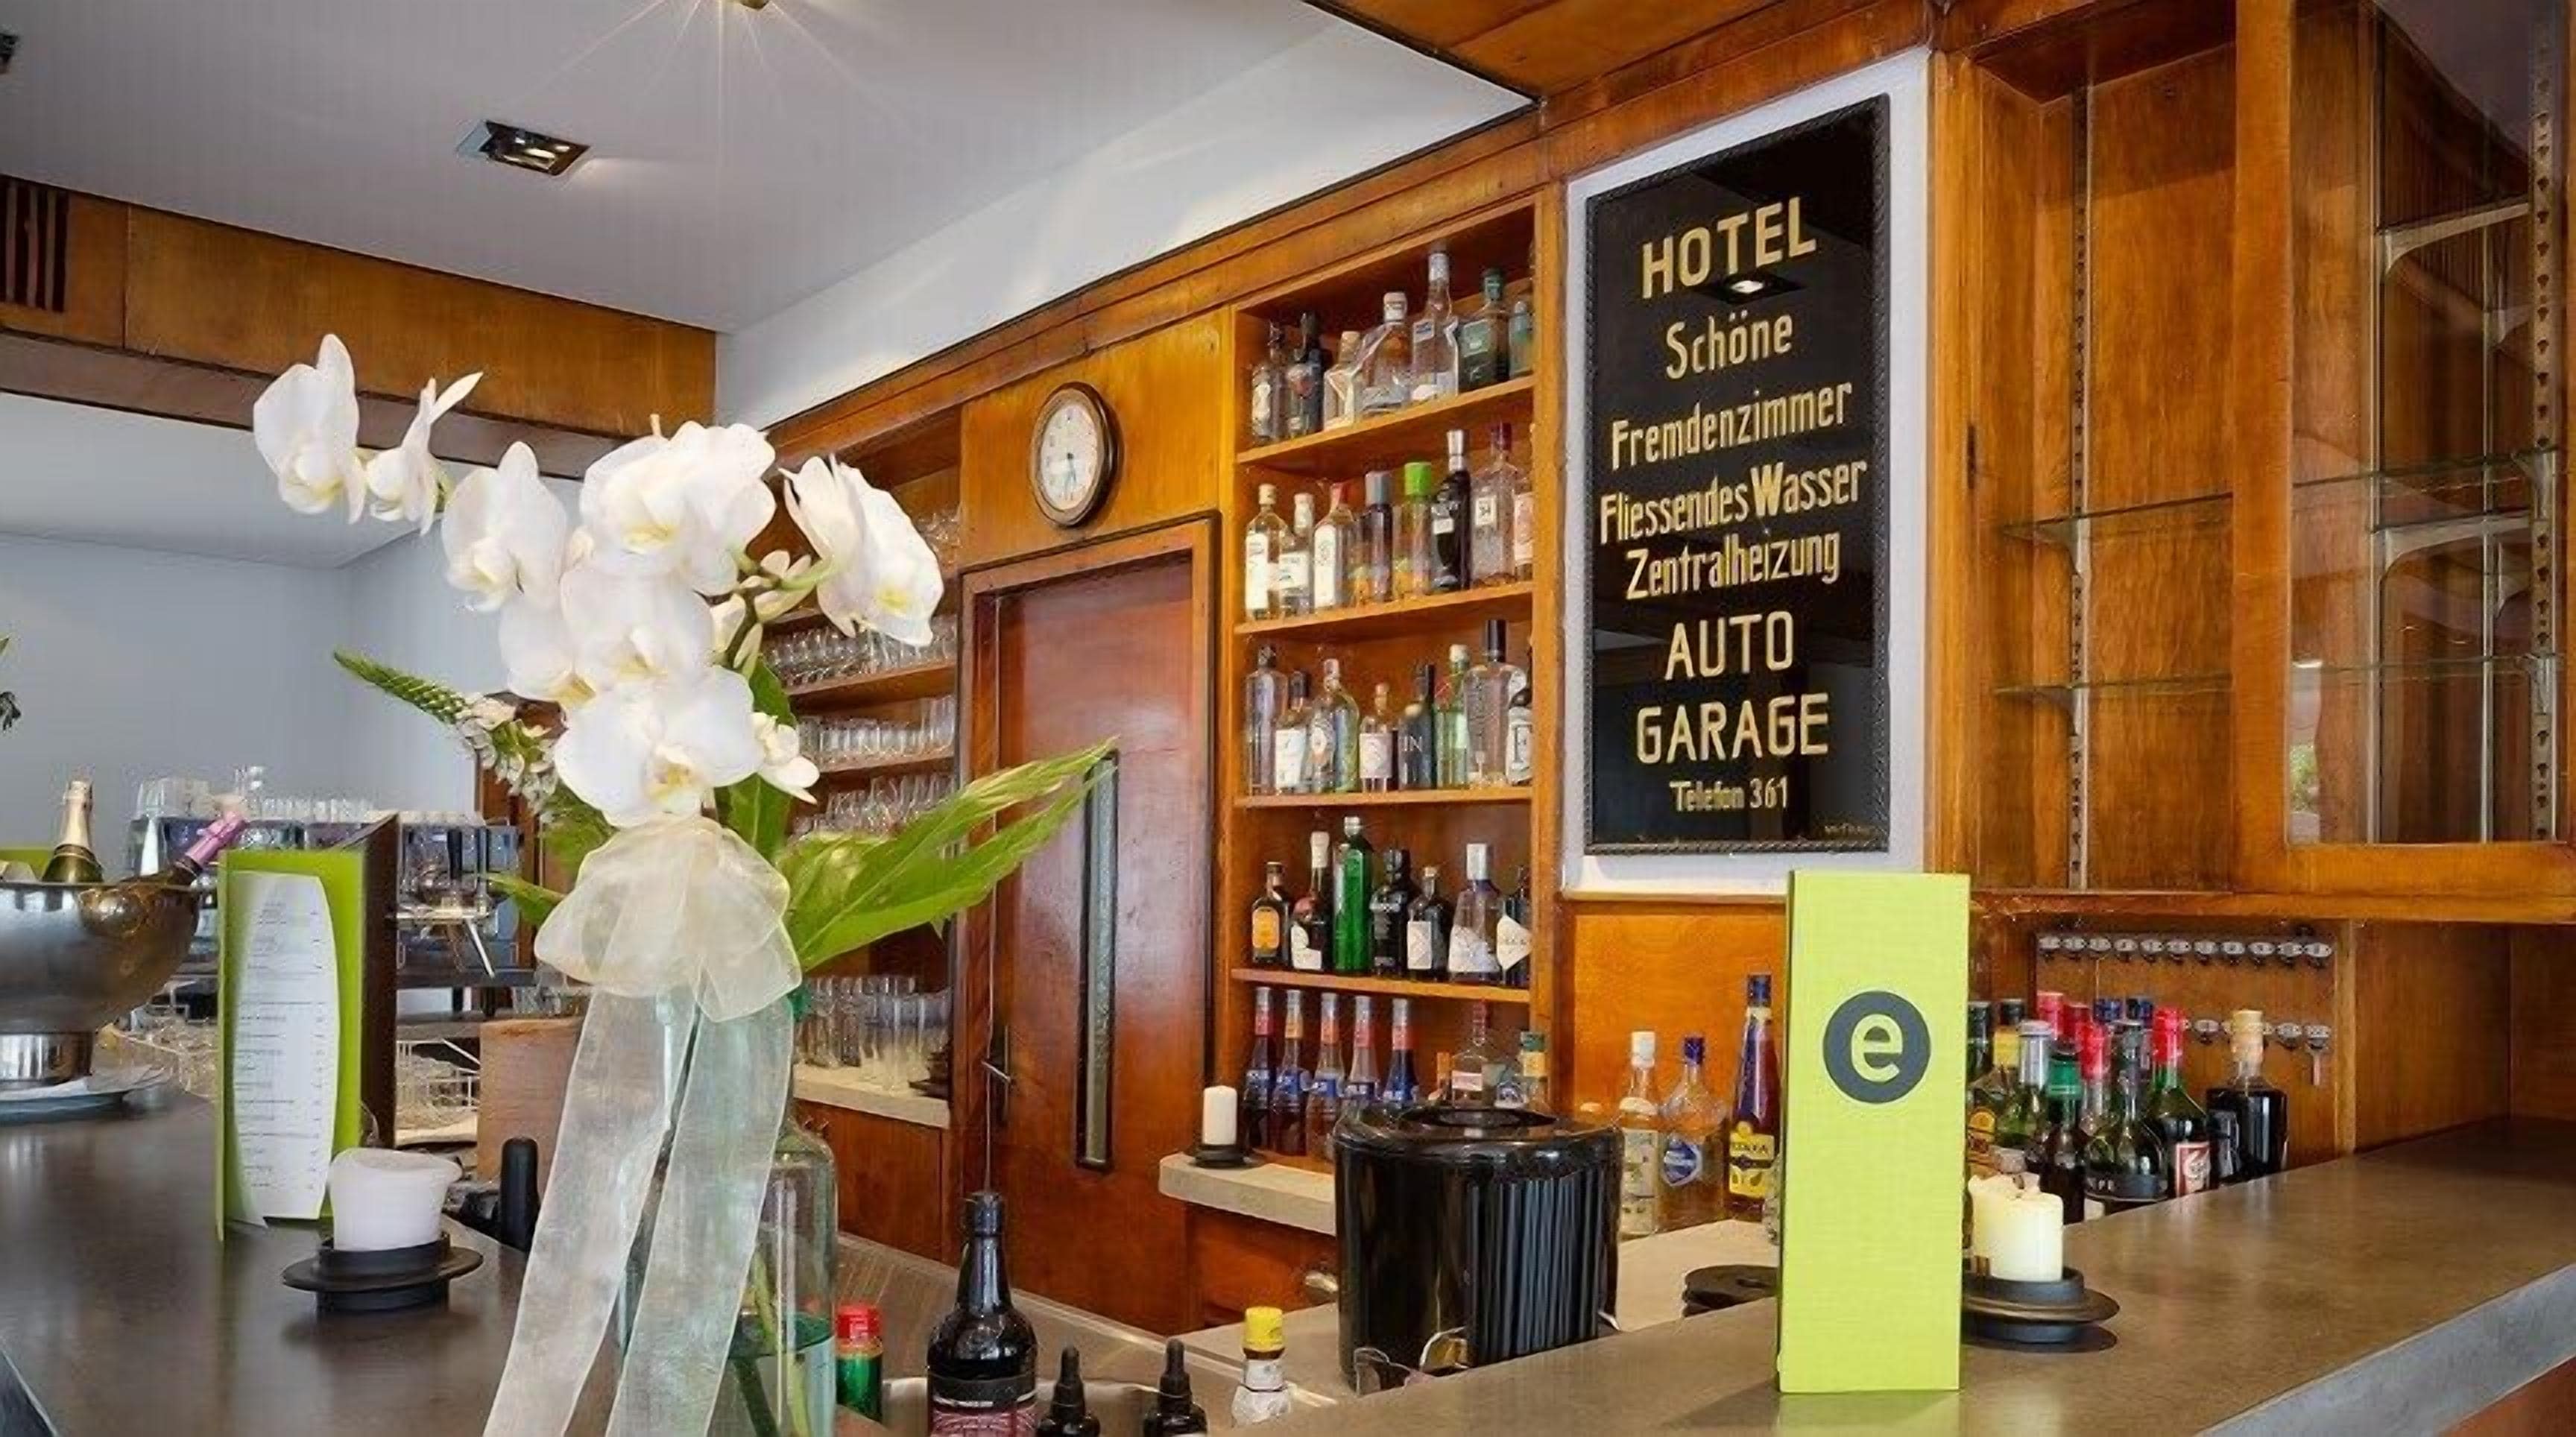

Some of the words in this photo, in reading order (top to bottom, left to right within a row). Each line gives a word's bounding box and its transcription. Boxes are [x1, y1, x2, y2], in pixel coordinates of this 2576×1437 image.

[1641, 197, 1816, 299] HOTEL
[1666, 309, 1793, 379] Schöne
[1611, 382, 1852, 471] Fremdenzimmer
[1750, 460, 1868, 517] Wasser
[1626, 527, 1840, 600] Zentralheizung
[1664, 610, 1794, 680] AUTO
[1638, 693, 1829, 764] GARAGE
[1669, 780, 1745, 812] Telefon
[1749, 776, 1787, 809] 361
[1852, 1014, 1903, 1082] e
